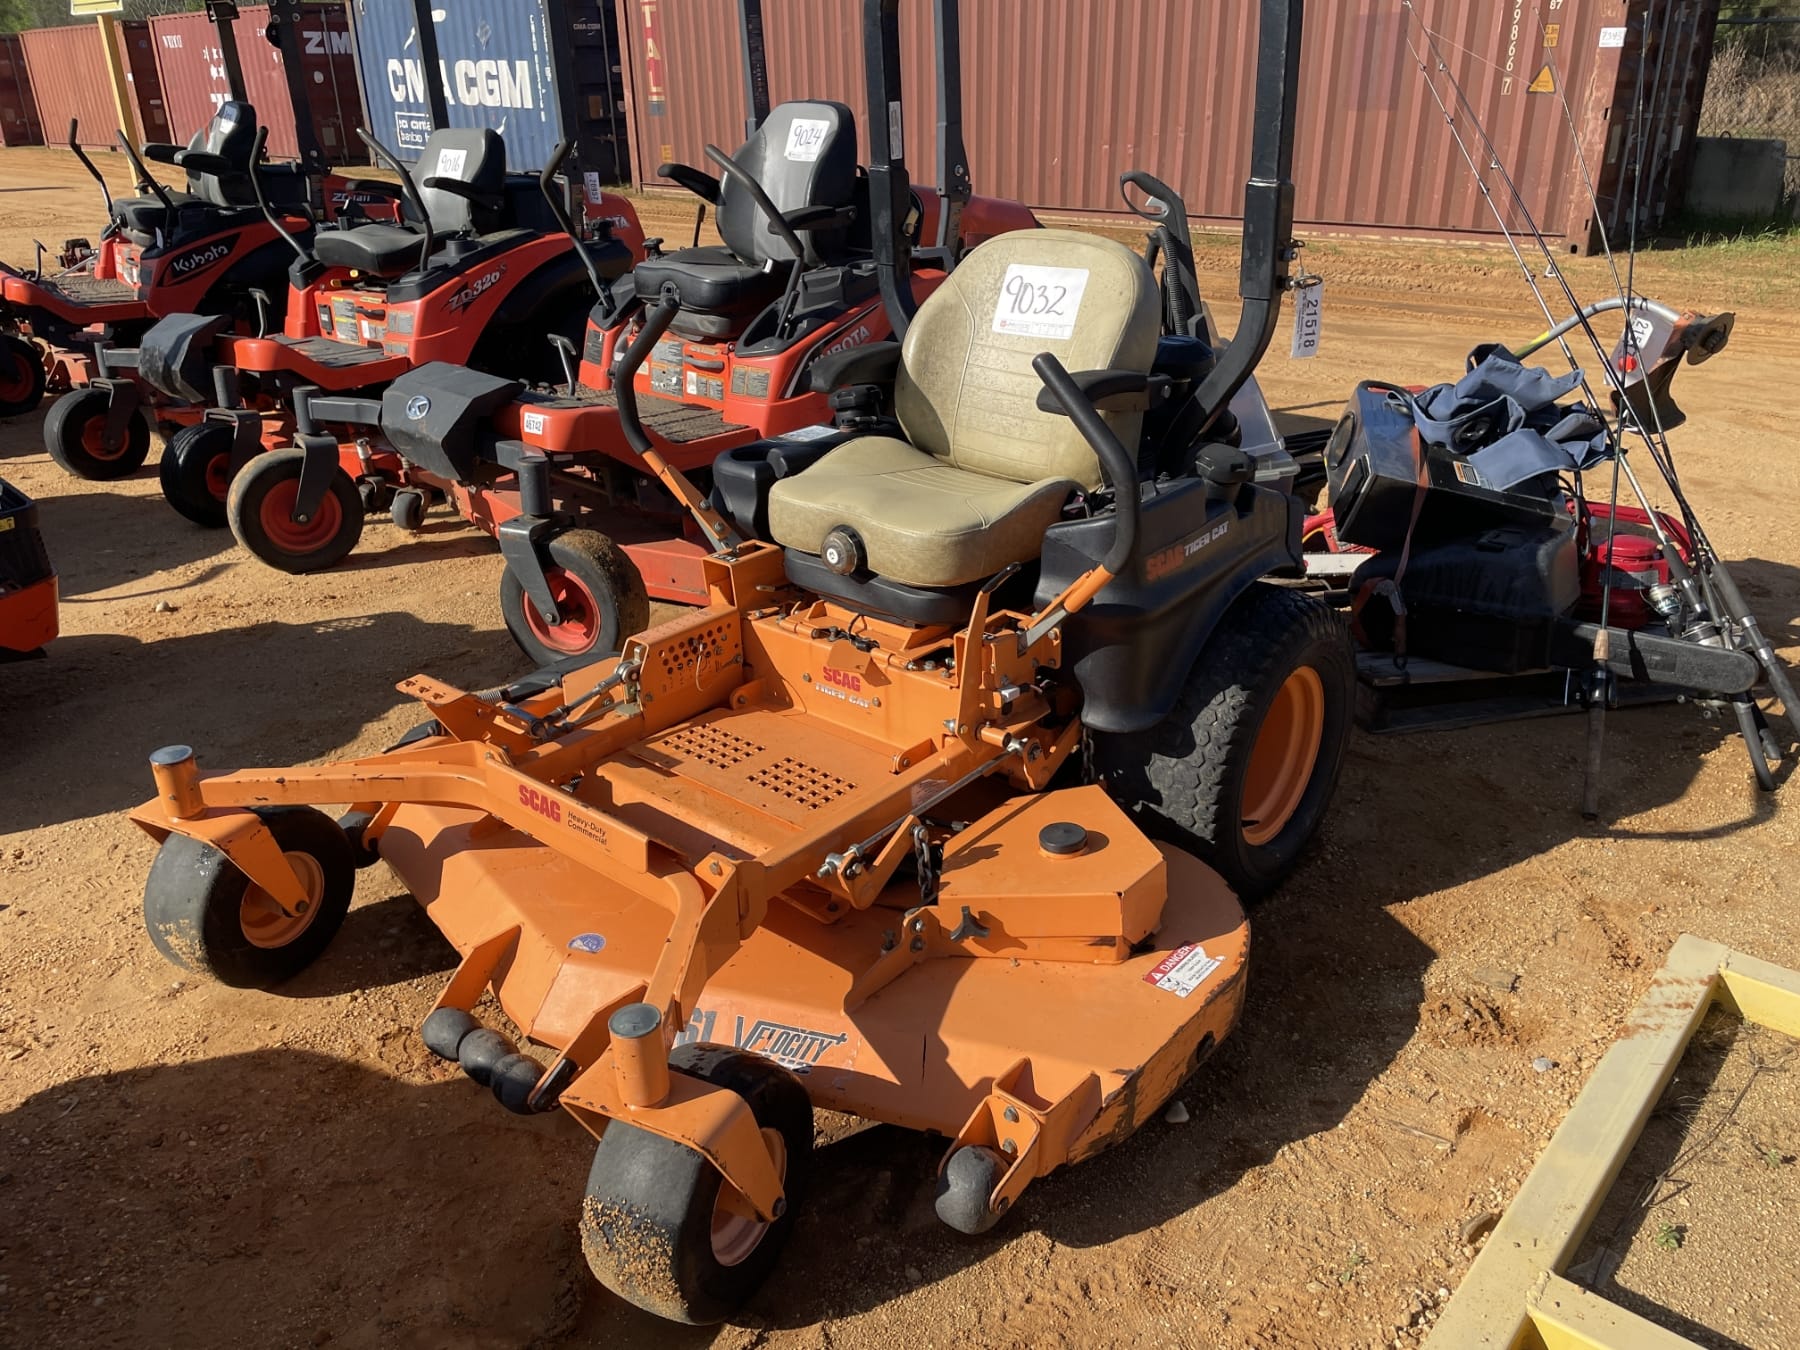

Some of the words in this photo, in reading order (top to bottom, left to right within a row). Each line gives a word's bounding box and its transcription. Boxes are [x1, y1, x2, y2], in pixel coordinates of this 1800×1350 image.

[302, 31, 353, 54] ZIM
[455, 59, 533, 109] CGM
[794, 124, 823, 148] 9024
[441, 154, 461, 173] 9016
[172, 244, 229, 271] Kubota
[1006, 274, 1067, 316] 9032
[1303, 299, 1319, 349] 21518
[1211, 520, 1229, 541] CAT
[823, 666, 861, 693] SCAG
[518, 784, 561, 822] SCAG
[567, 810, 606, 836] Heavy-Duty
[567, 819, 607, 846] Commercial
[1160, 945, 1193, 972] DANGER
[734, 1015, 848, 1064] VELOCITY
